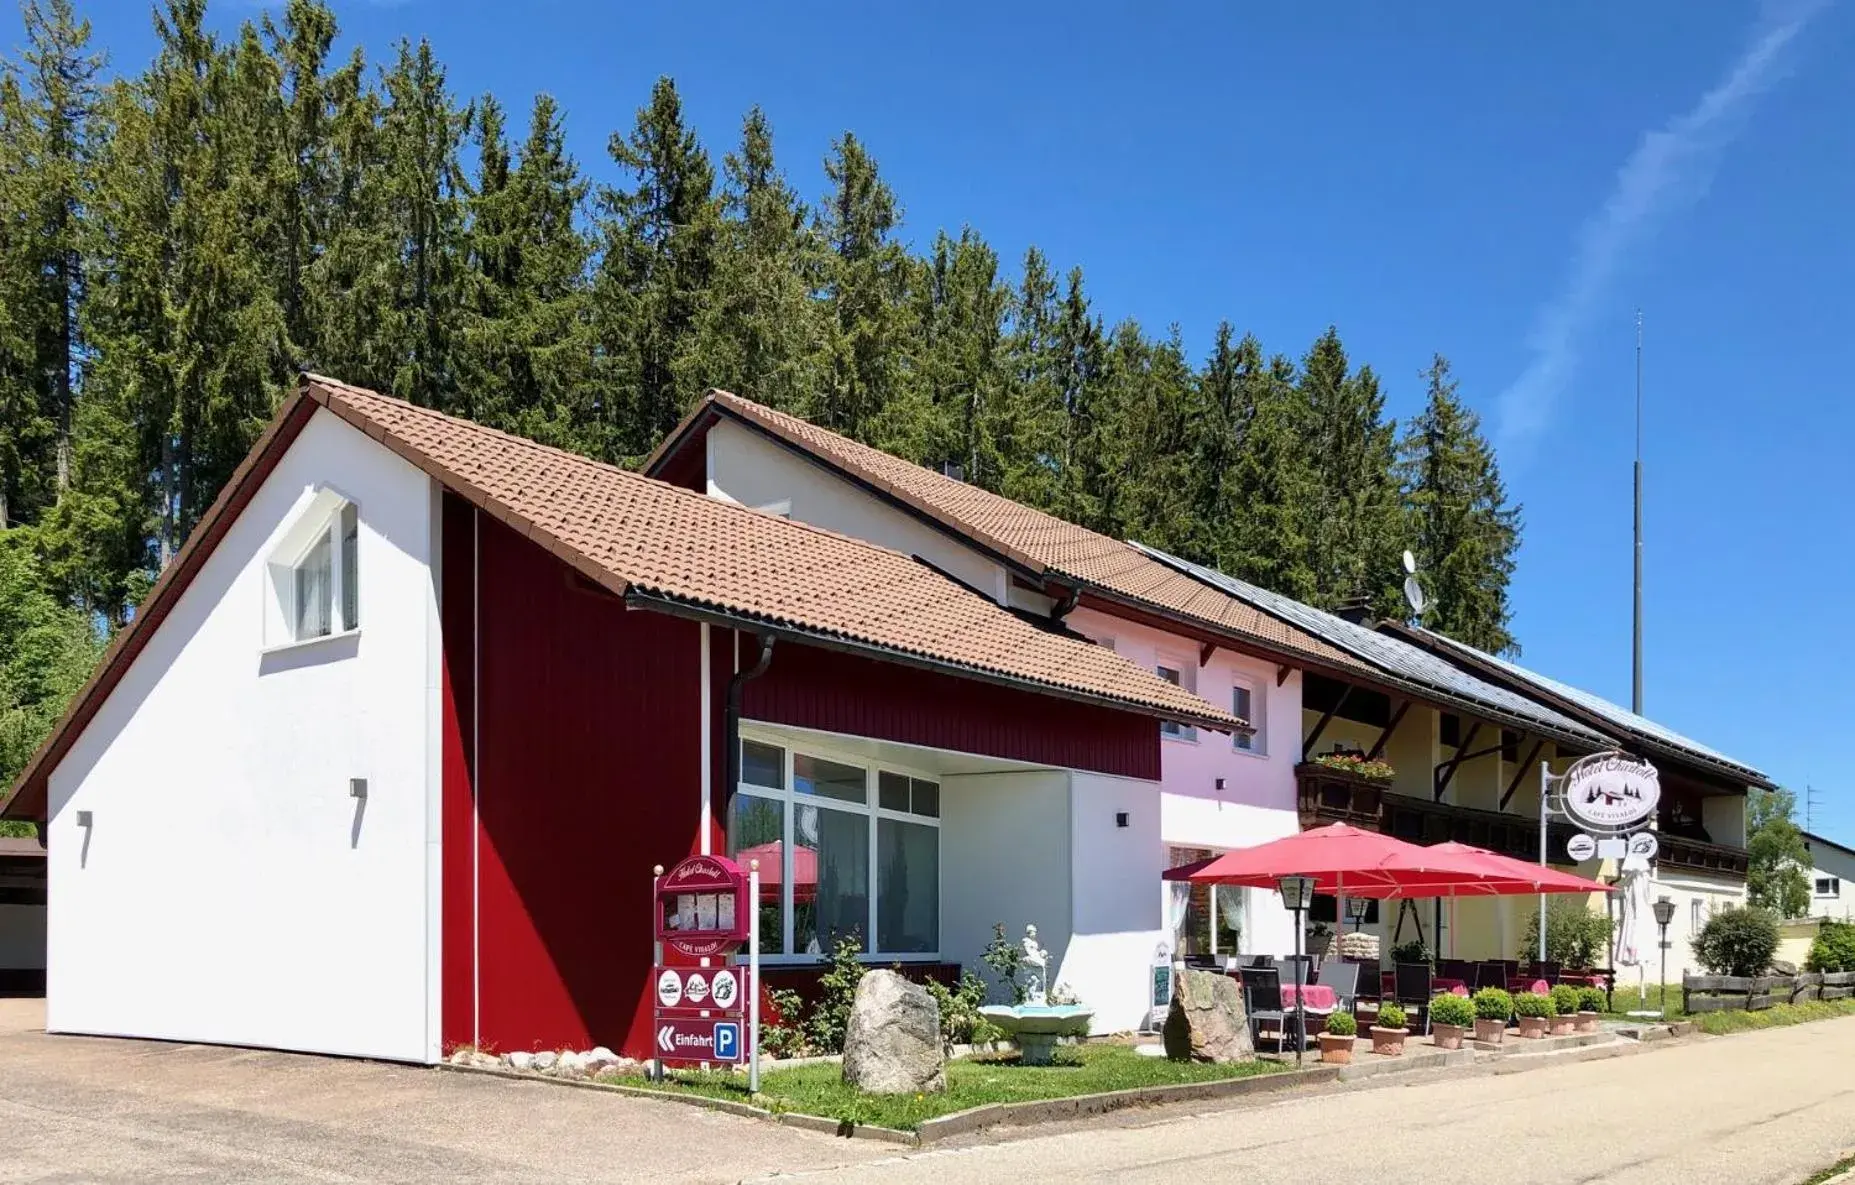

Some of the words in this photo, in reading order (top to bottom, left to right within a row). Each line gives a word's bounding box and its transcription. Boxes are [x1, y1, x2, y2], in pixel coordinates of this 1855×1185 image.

[1571, 757, 1603, 785] Hotel
[678, 864, 695, 881] Hotel
[694, 941, 718, 953] VIVALDI
[675, 1033, 713, 1047] Einfahrt
[719, 1029, 733, 1053] P
